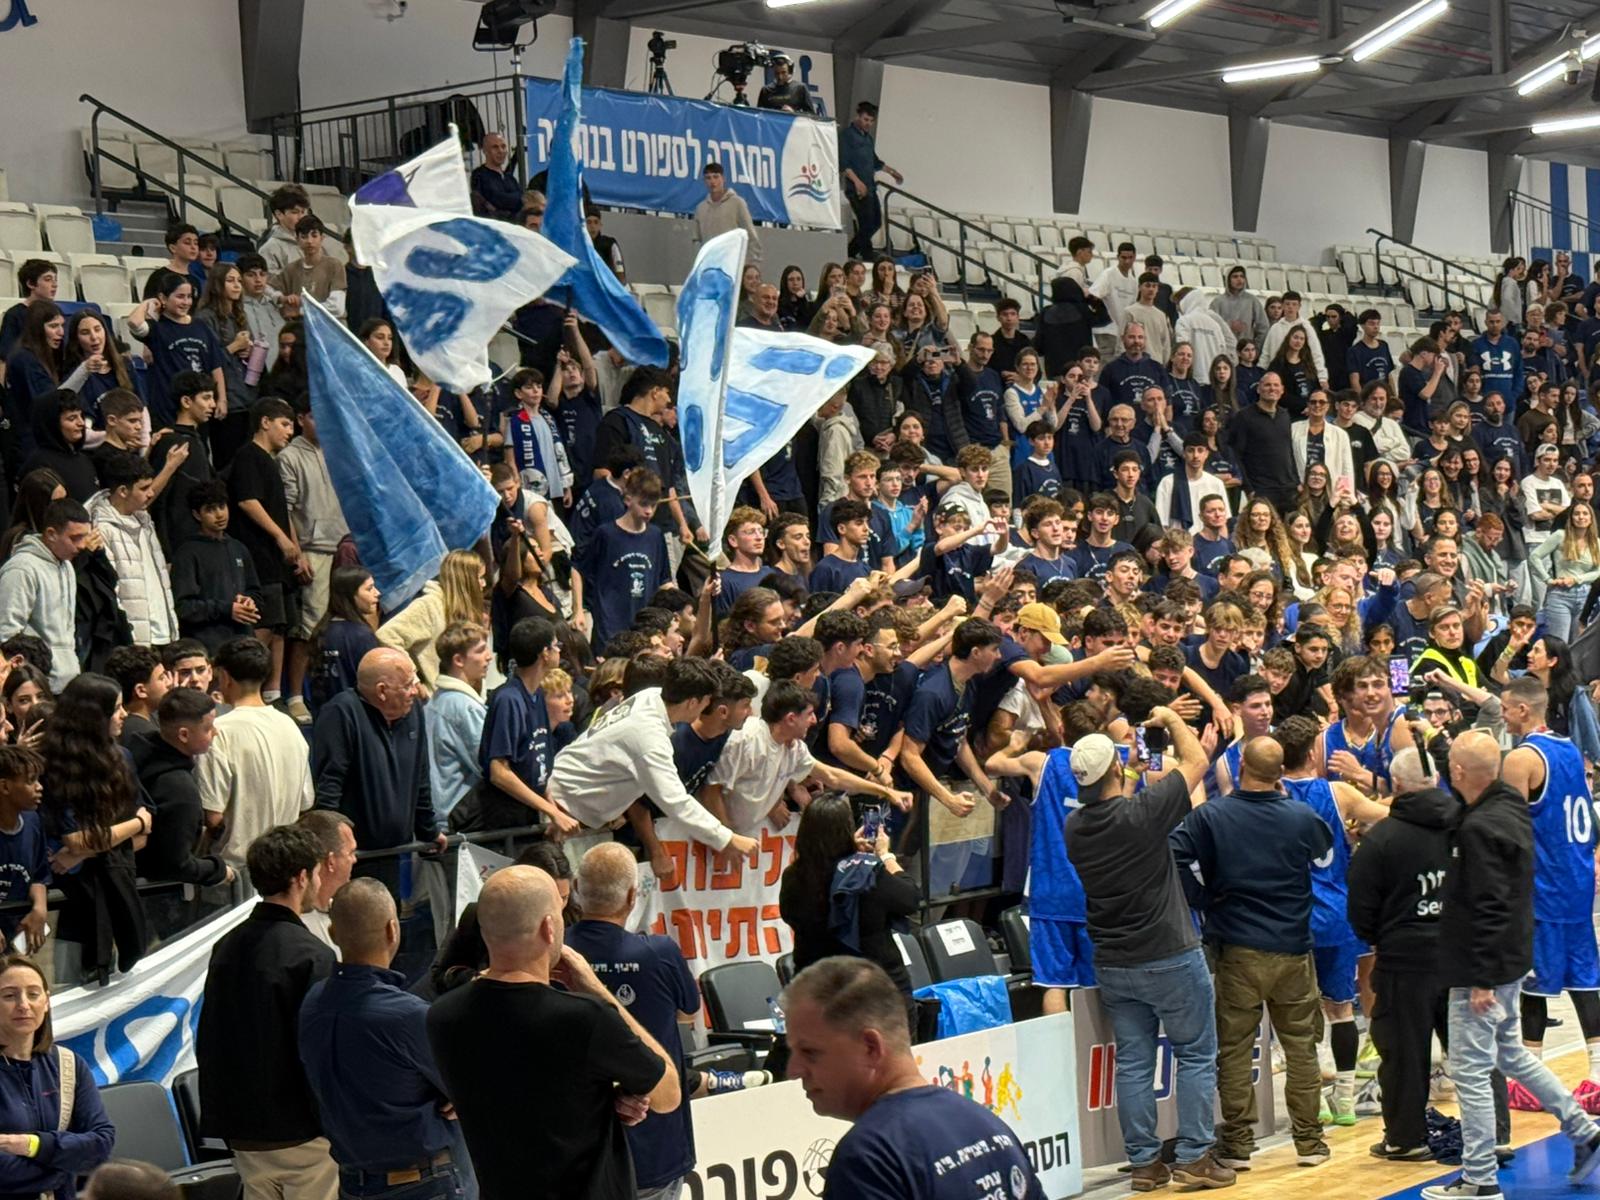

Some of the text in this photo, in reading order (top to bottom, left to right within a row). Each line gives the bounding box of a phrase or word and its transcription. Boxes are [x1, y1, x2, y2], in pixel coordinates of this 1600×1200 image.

[621, 129, 702, 180] לספורט
[1563, 794, 1593, 844] 10
[1416, 899, 1444, 917] Se
